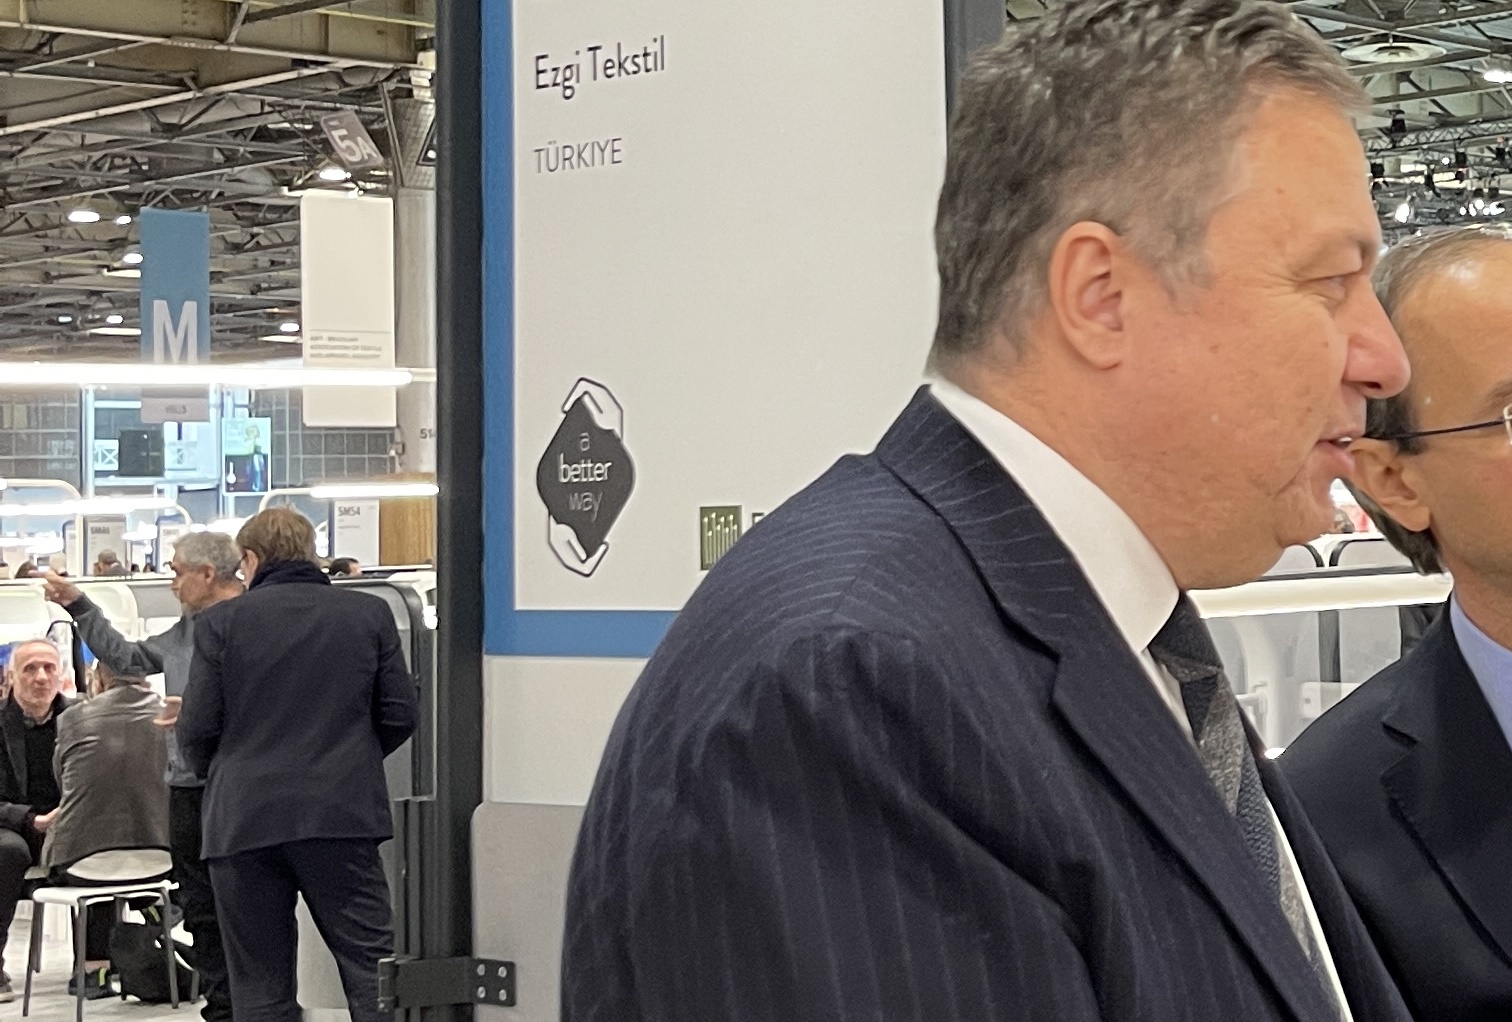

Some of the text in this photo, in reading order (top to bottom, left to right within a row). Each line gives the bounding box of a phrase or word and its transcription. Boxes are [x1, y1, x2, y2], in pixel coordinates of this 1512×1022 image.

[535, 35, 665, 100] Ezgi Tekstil
[534, 137, 622, 174] TÜRKIYE
[153, 299, 198, 365] M
[580, 432, 591, 452] a
[559, 452, 613, 483] better
[569, 491, 604, 523] way
